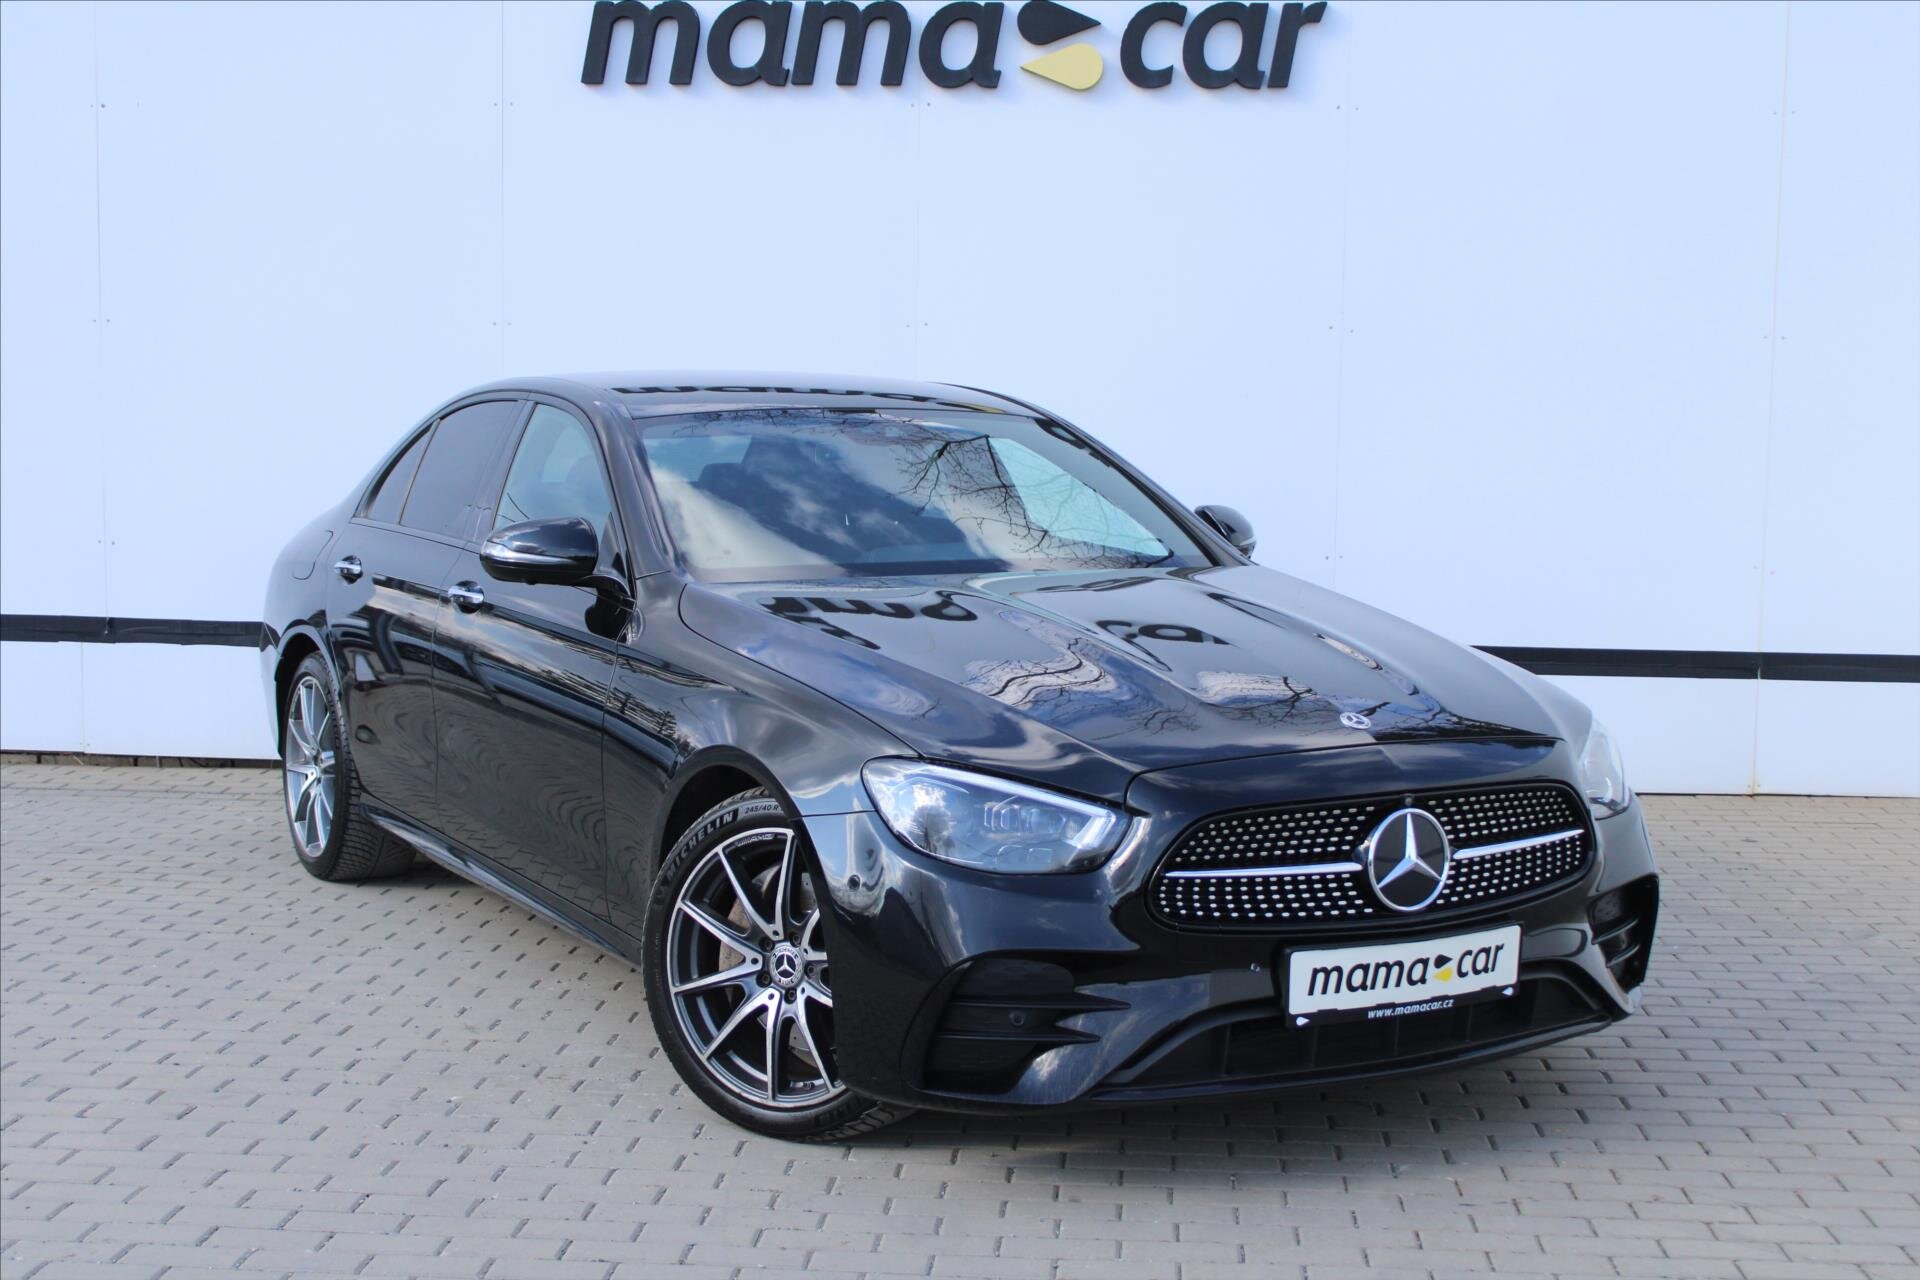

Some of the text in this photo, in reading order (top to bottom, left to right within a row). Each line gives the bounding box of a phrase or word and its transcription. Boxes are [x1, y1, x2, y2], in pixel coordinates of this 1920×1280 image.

[581, 0, 1328, 89] mama car
[666, 811, 734, 881] MICHELIN
[1307, 943, 1505, 996] mama car
[1367, 998, 1455, 1019] www.mamacar.cz
